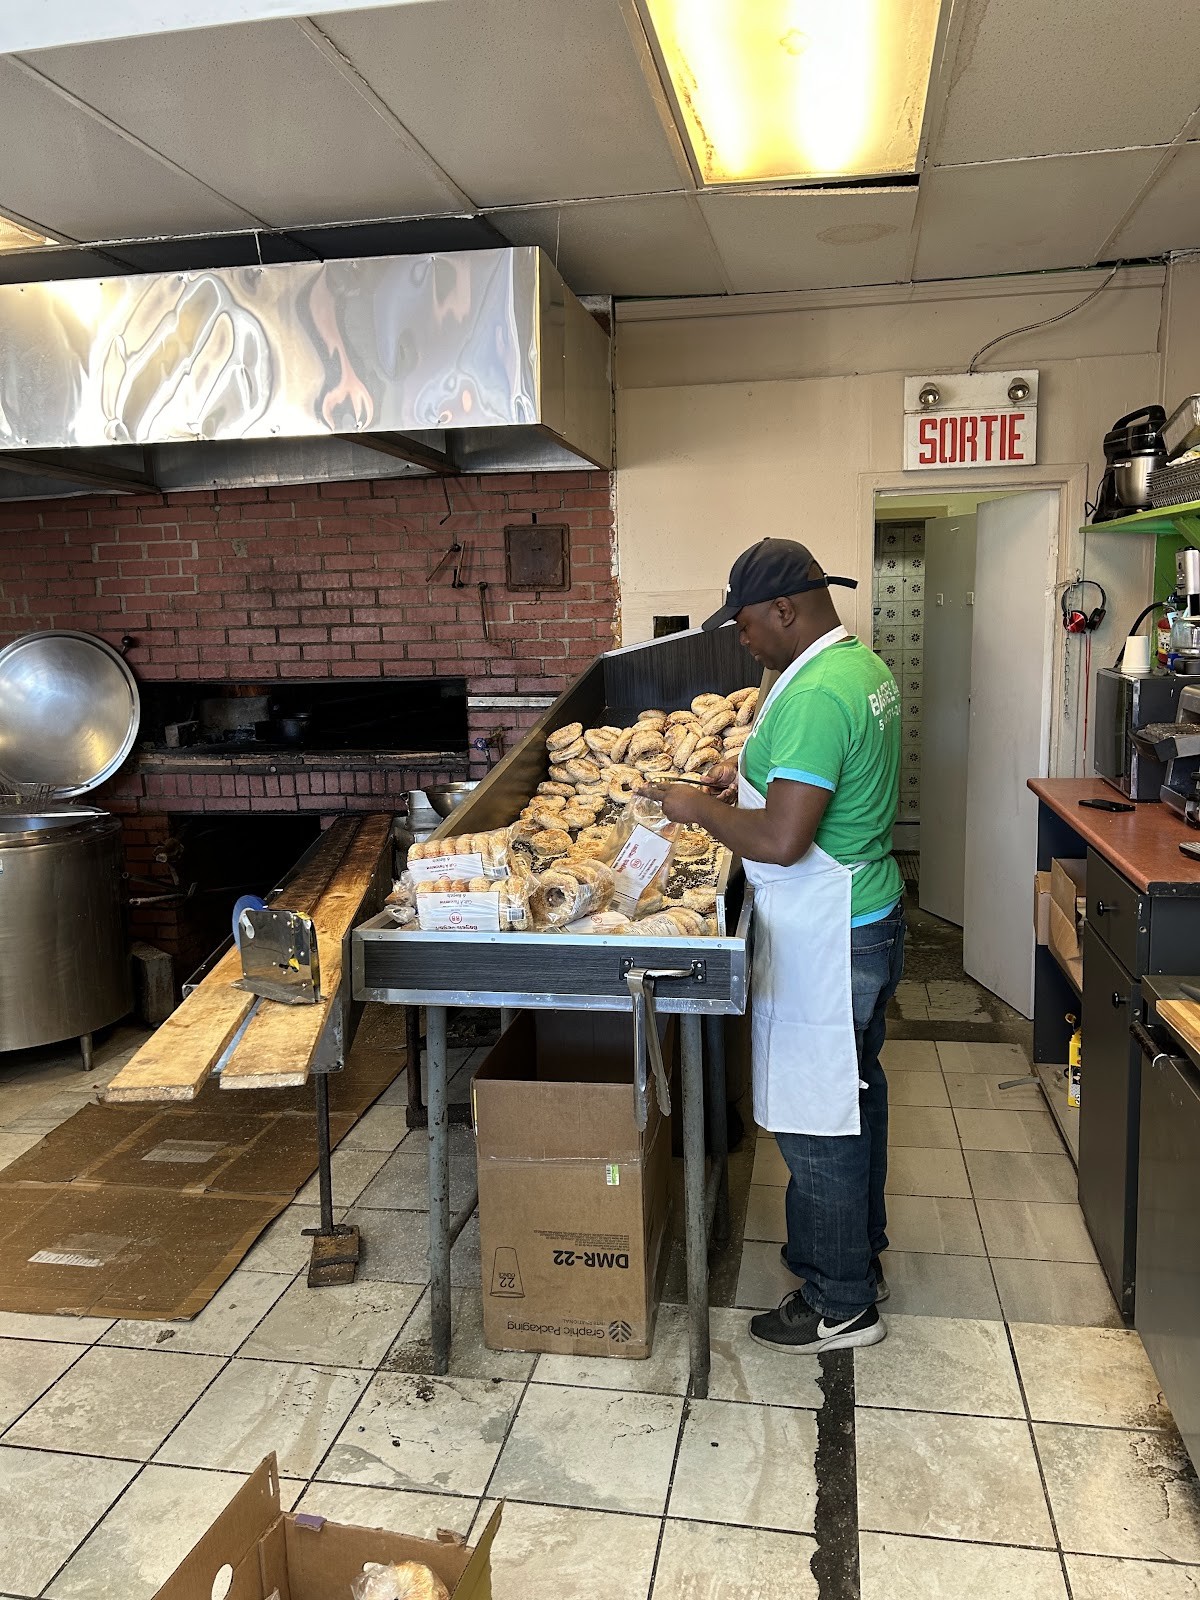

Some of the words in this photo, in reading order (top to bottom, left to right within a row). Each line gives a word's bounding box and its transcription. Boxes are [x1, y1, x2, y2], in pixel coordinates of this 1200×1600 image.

[919, 413, 1025, 464] SORTIE
[552, 1249, 629, 1269] DMR-22
[499, 1277, 515, 1289] 22
[507, 1321, 561, 1336] Packaging
[563, 1326, 605, 1339] Graphic
